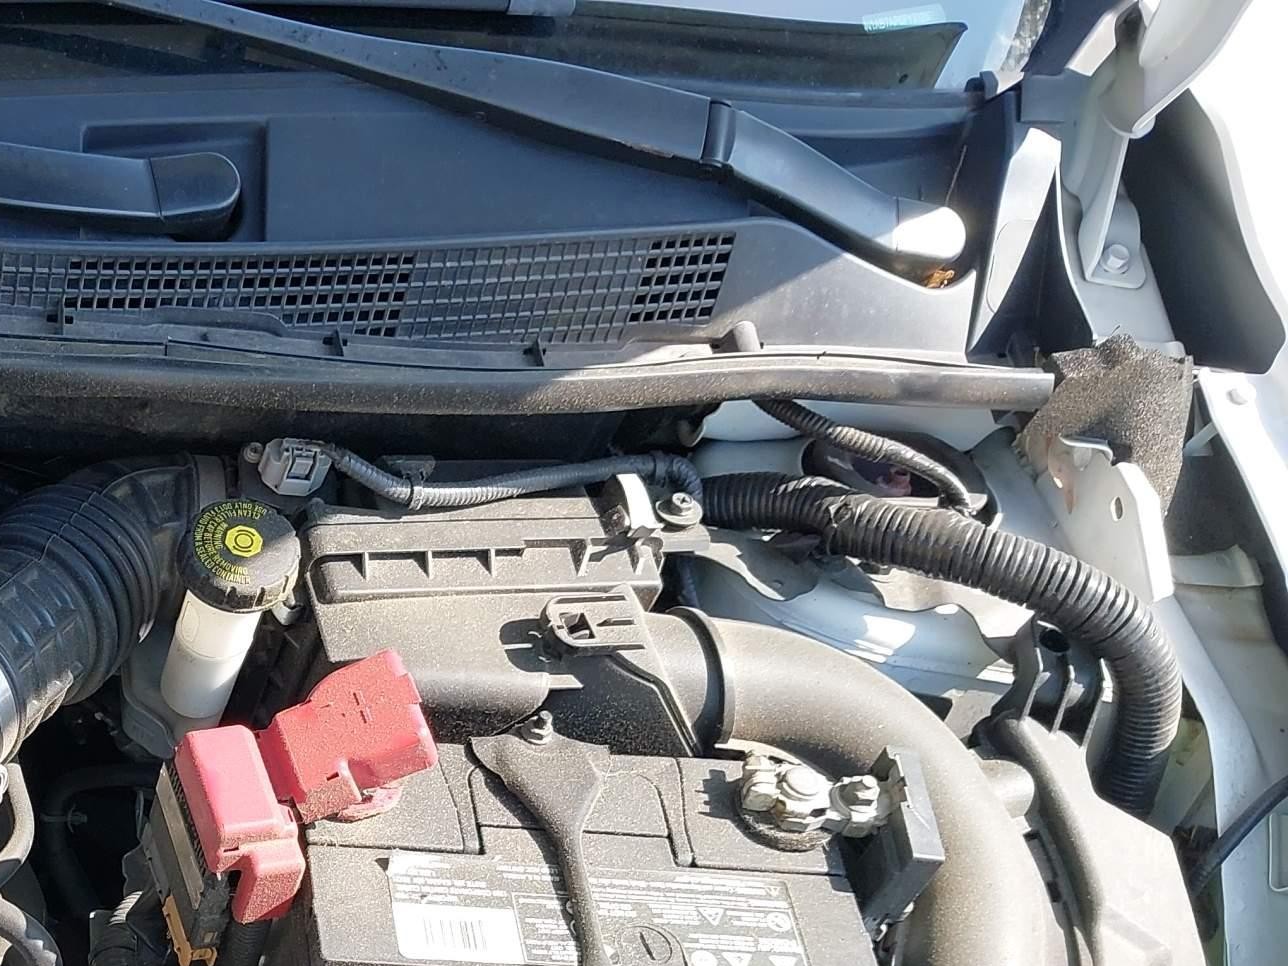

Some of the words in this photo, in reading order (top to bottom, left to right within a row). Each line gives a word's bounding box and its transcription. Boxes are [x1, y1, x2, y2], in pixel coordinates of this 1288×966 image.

[235, 502, 252, 510] ONLY
[255, 504, 267, 516] USE
[199, 510, 215, 524] FLUID
[215, 510, 236, 524] FILLER
[237, 510, 260, 519] CLEAN
[195, 525, 204, 540] FROM
[206, 521, 216, 532] CAP
[214, 522, 228, 550] WARNING
[204, 532, 215, 555] BEFORE
[196, 547, 215, 568] SEALED
[214, 555, 248, 575] REMOVING
[213, 566, 251, 584] CONTAINER
